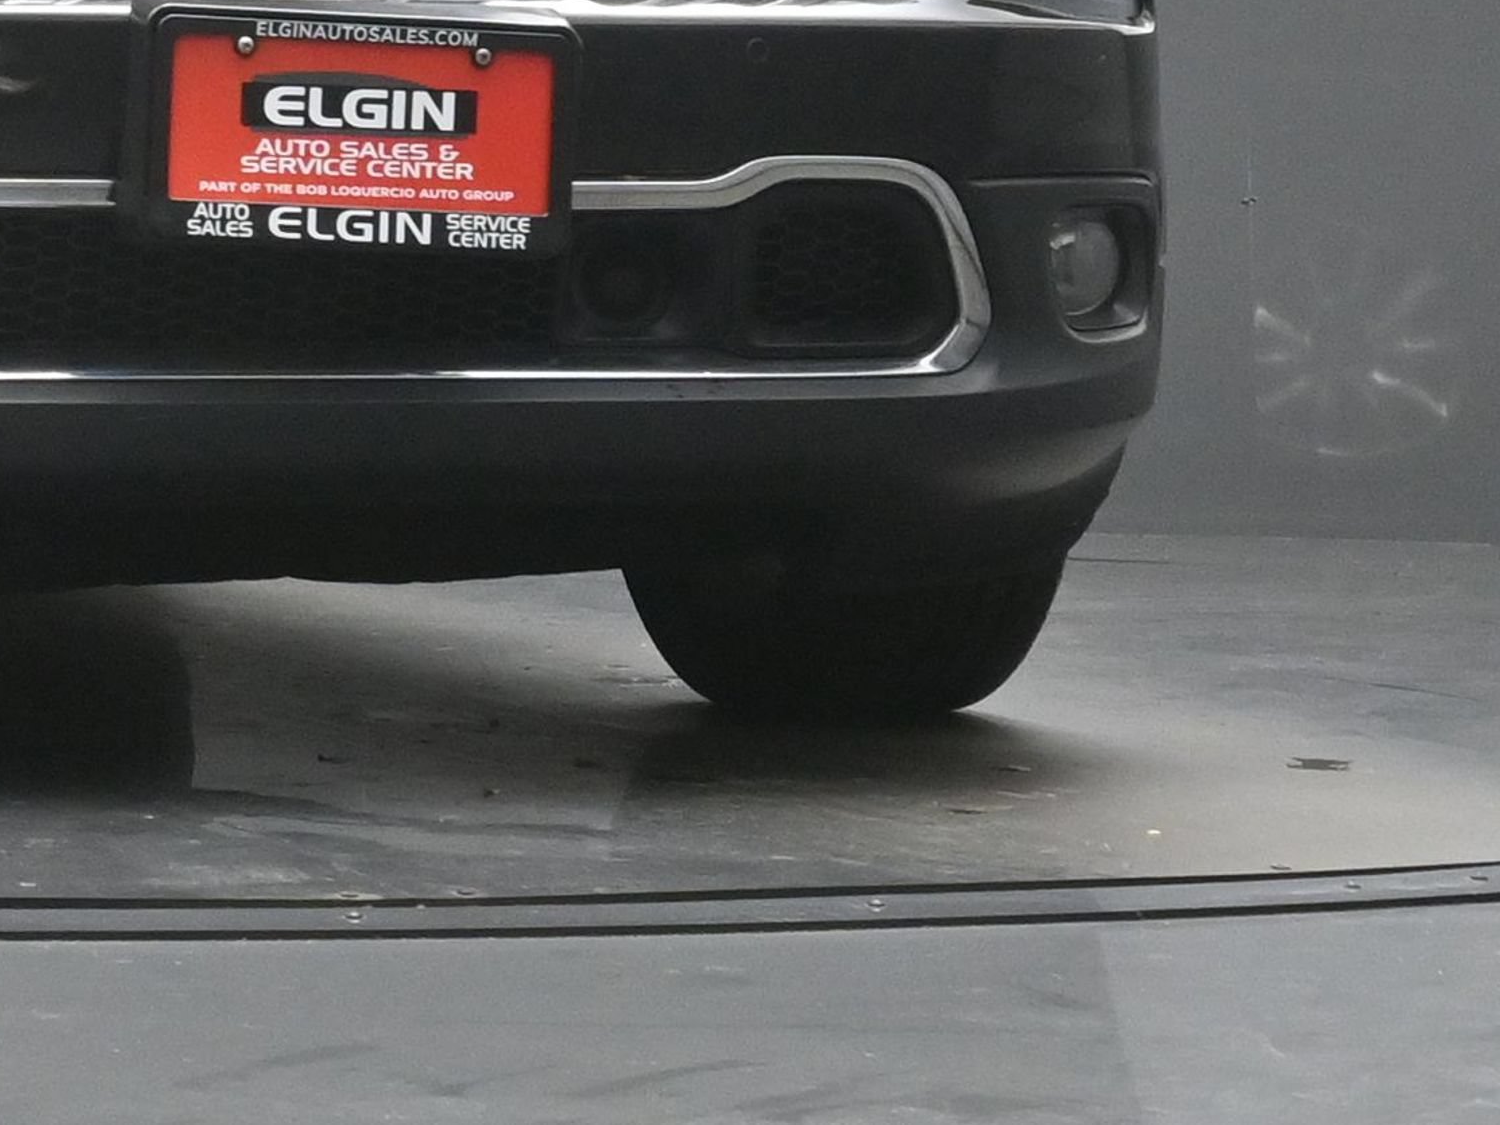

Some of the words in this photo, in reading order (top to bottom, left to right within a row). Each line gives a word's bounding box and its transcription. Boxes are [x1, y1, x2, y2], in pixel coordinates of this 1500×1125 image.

[256, 20, 478, 46] ELGINAUTOSALES.COM
[263, 85, 456, 131] ELGIN
[254, 138, 330, 157] AUTO
[339, 141, 429, 161] SALES
[438, 144, 460, 162] &
[240, 155, 358, 176] SERVICE
[366, 160, 474, 180] CENTER
[199, 180, 237, 192] PART
[240, 181, 261, 193] OF
[264, 183, 293, 195] THE
[296, 184, 327, 196] BOB
[331, 185, 416, 199] LOQUERCIO
[419, 188, 459, 200] AUTO
[462, 190, 514, 201] GROUP
[194, 201, 250, 220] AUTO
[187, 219, 253, 238] SALES
[268, 206, 432, 245] ELGIN
[445, 213, 531, 233] SERVICE
[448, 231, 527, 250] CENTER
